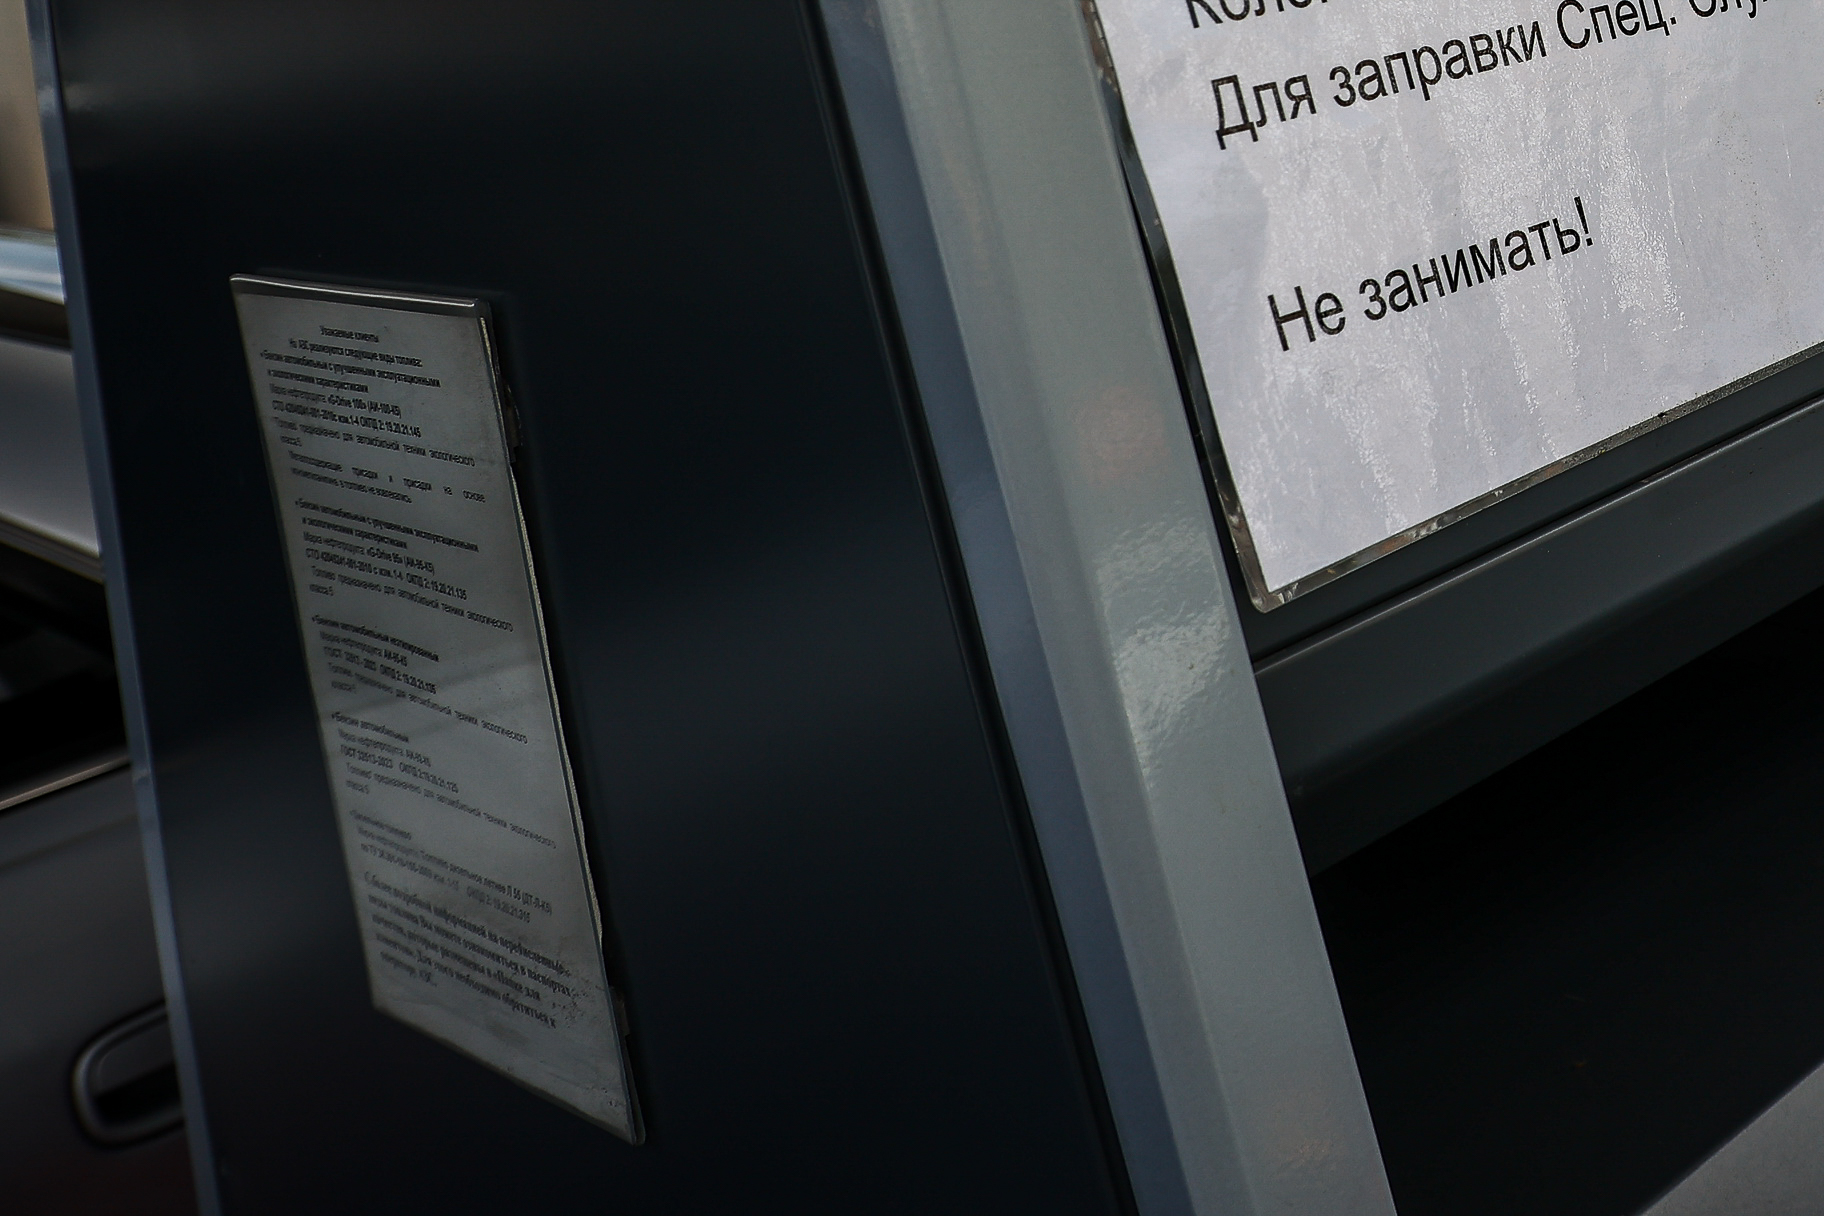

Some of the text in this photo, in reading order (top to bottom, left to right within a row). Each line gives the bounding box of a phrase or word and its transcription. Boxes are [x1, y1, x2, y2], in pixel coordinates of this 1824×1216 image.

[1210, 74, 1318, 150] Для
[1329, 21, 1548, 102] заправки
[1267, 196, 1595, 352] Не занимать!
